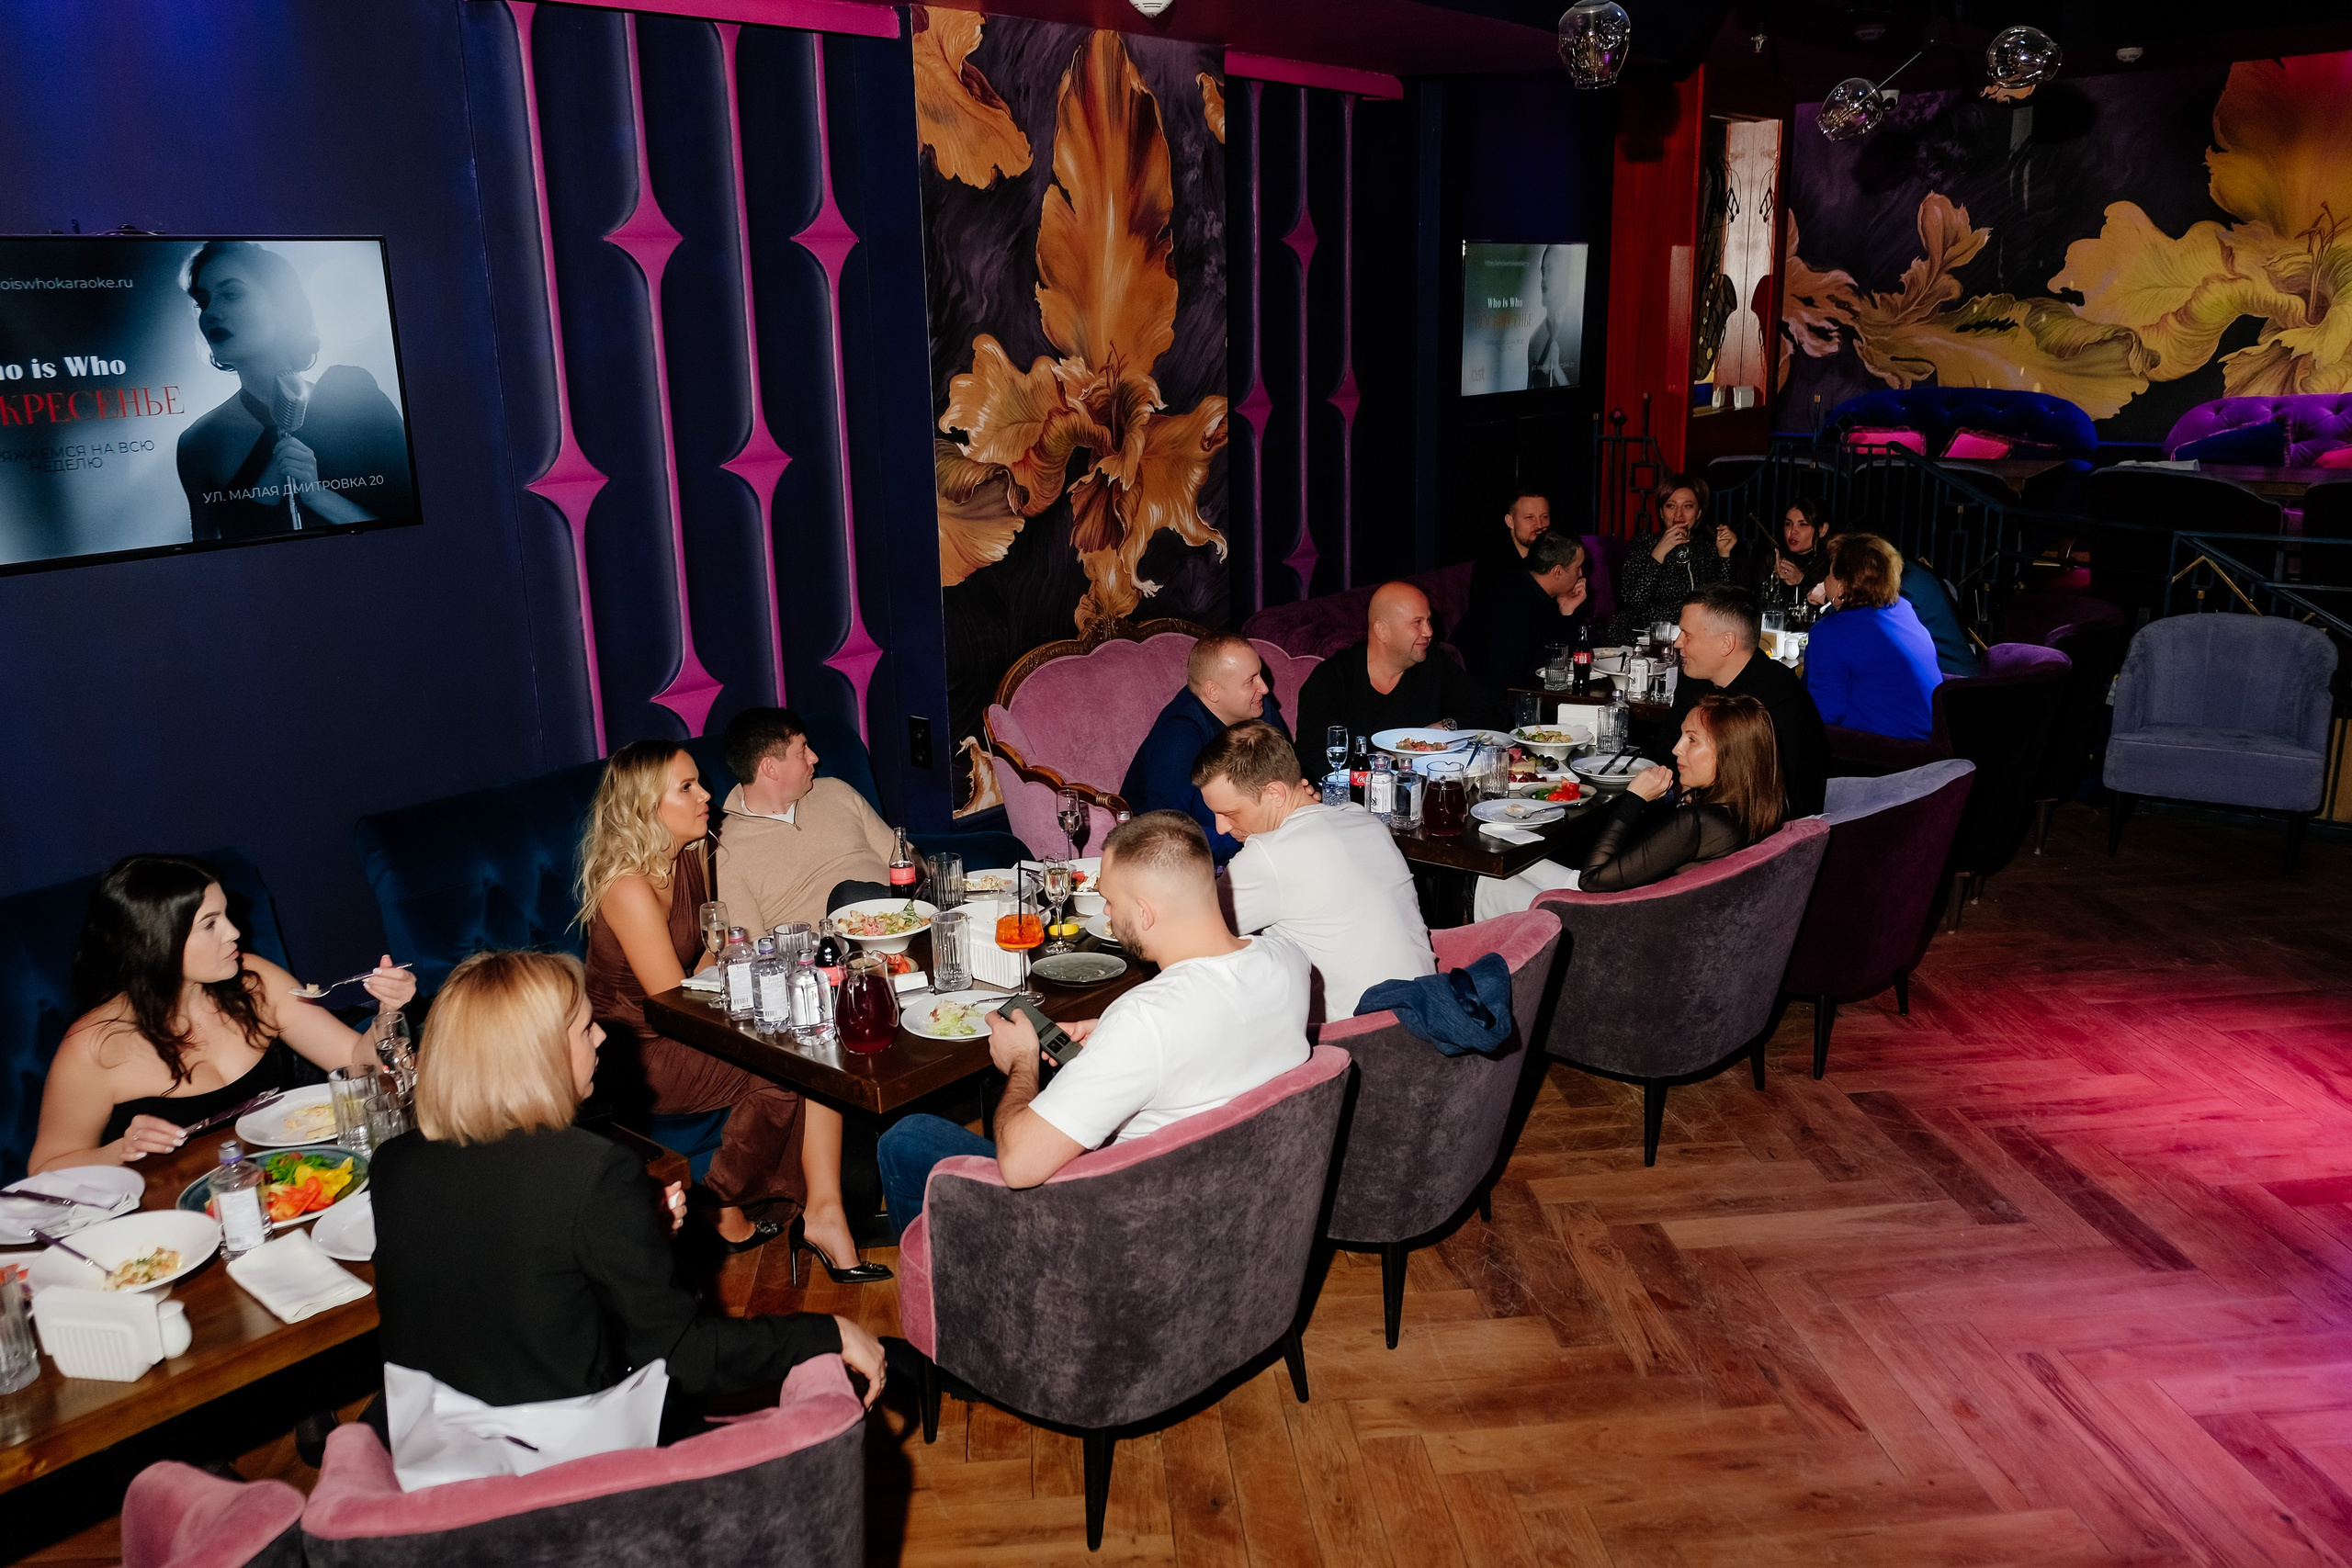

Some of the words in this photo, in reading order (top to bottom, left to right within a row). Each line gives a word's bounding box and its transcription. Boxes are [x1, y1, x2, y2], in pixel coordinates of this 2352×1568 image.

[1487, 298, 1501, 309] Who
[1510, 297, 1523, 308] Who
[31, 358, 57, 379] is
[63, 355, 127, 377] Who
[92, 443, 115, 456] НА
[119, 440, 155, 454] ВСЮ
[31, 457, 103, 473] НЕДЕЛЮ
[202, 491, 226, 503] УЛ.
[229, 485, 279, 502] МАЛАЯ
[283, 477, 368, 497] ДМИТРОВКА
[369, 475, 384, 486] 20
